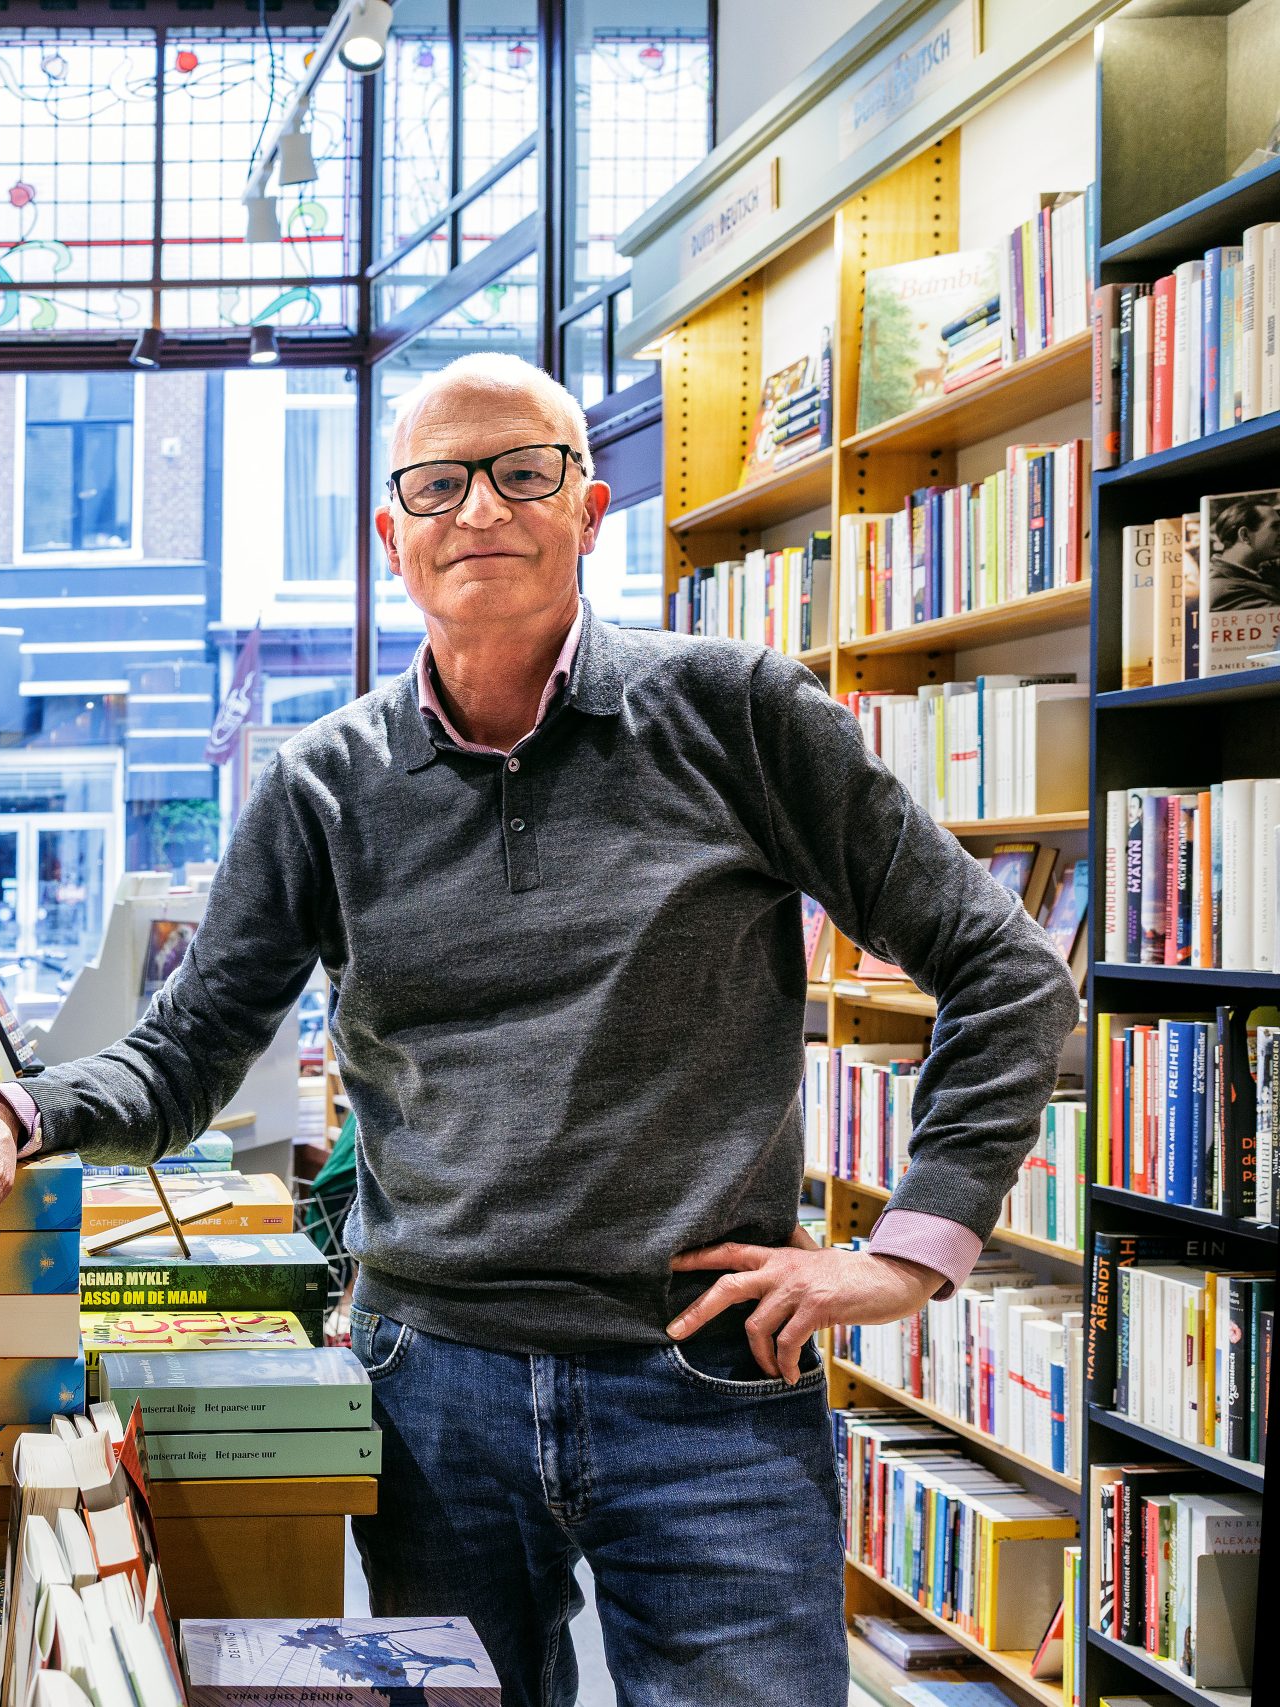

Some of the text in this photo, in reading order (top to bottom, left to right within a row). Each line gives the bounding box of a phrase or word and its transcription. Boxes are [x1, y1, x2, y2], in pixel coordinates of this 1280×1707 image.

[899, 265, 982, 301] Bambi
[1205, 254, 1213, 323] Florian Illies
[1120, 291, 1132, 334] Exil
[1211, 616, 1238, 628] DER
[1211, 628, 1262, 643] FRED
[1211, 662, 1246, 671] DANIEL
[1131, 839, 1142, 893] MANN
[1105, 846, 1116, 934] WUNDERLAND
[1197, 1031, 1206, 1094] der Schriftsteller
[1168, 1029, 1179, 1182] ANGELA MERKEL FREIHEIT
[1271, 1040, 1279, 1148] SCHICKSALSSTUNDEN
[1258, 1137, 1271, 1206] Weimar
[223, 1216, 249, 1227] van X
[1186, 1240, 1226, 1256] EIN
[123, 1290, 207, 1304] OM DE MAAN
[125, 1271, 170, 1286] MYKLE
[1095, 1255, 1110, 1331] ARENDT
[1087, 1302, 1097, 1380] HANNAH
[1228, 1352, 1239, 1406] Organisch
[176, 1403, 196, 1415] Roig
[204, 1403, 219, 1412] Het
[221, 1405, 249, 1415] paarse
[145, 1450, 277, 1462] ontserrat Roig Het paarse uur
[1123, 1485, 1132, 1543] Eigenschaften
[1123, 1567, 1131, 1608] Kontinent
[225, 1631, 241, 1659] DEINING
[300, 1692, 354, 1702] DEINING
